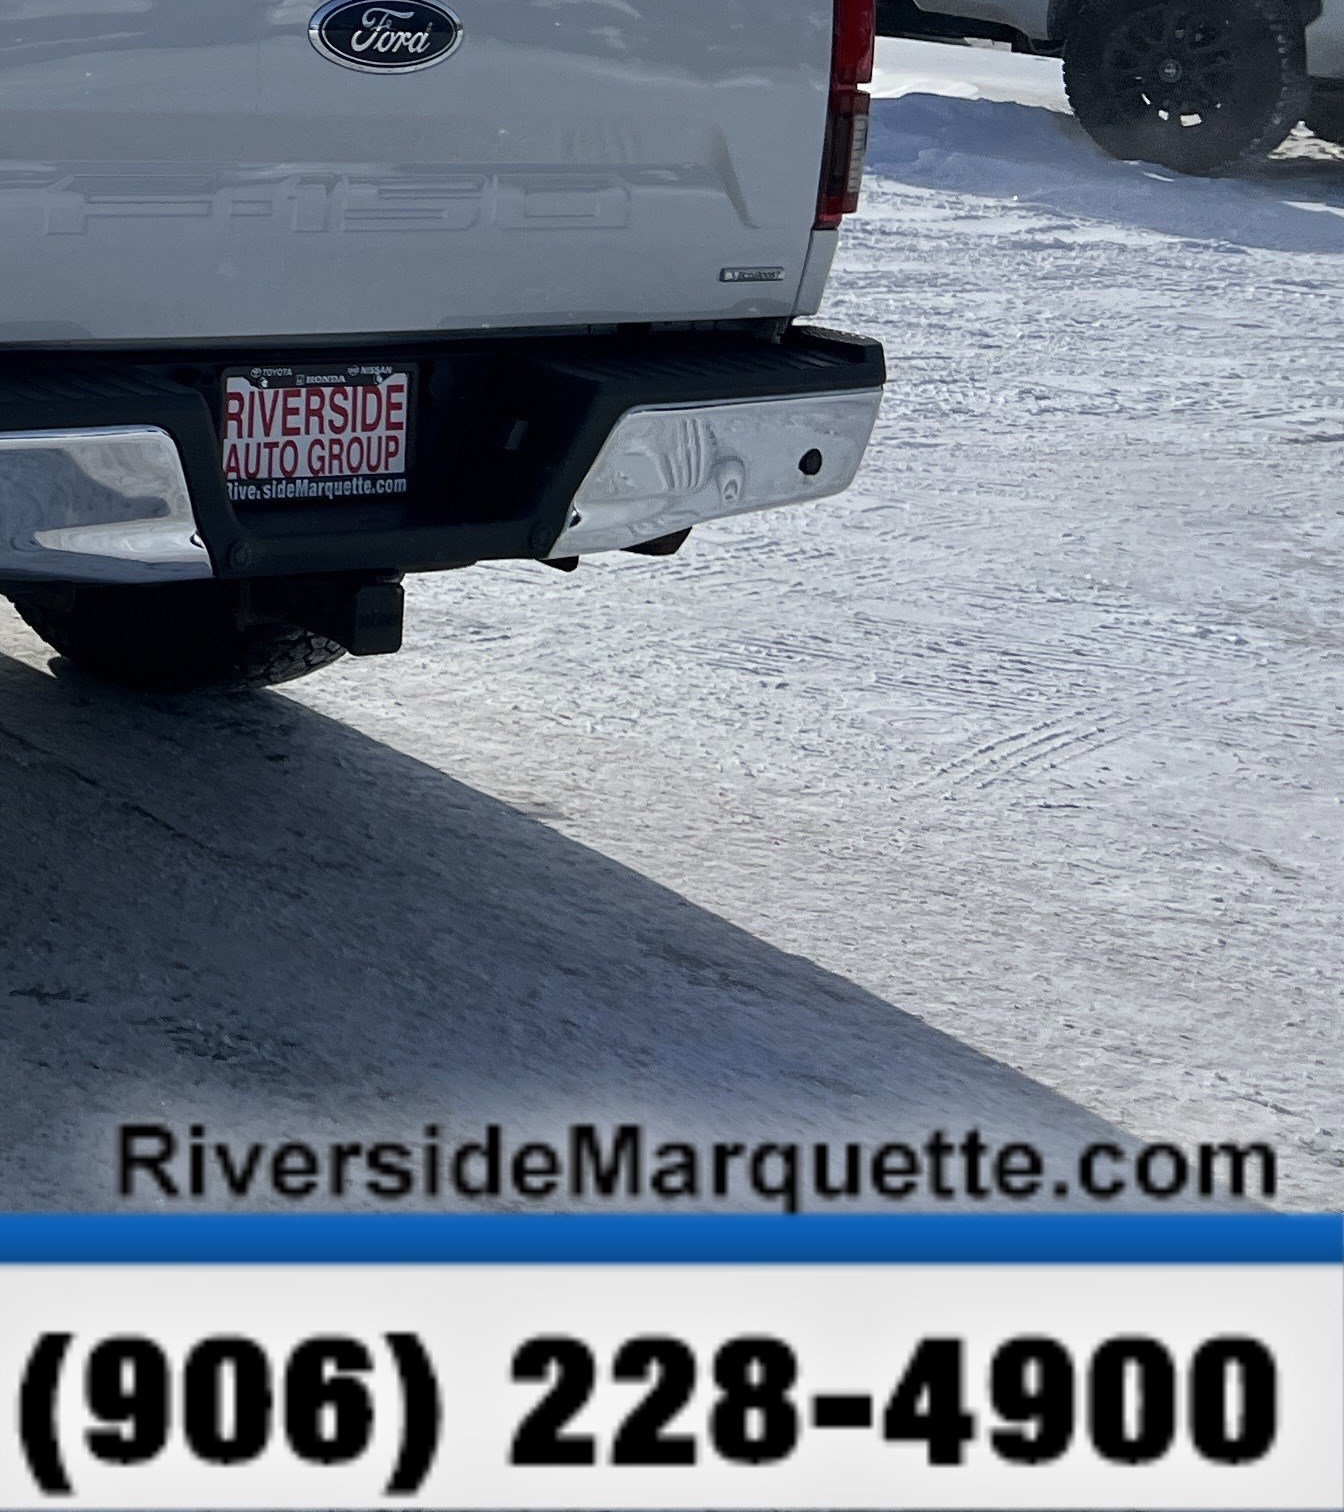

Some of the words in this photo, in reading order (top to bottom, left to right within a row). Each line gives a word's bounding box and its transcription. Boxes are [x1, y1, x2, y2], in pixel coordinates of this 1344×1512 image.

[350, 7, 434, 54] Ford
[262, 367, 293, 377] TOYOTA
[306, 374, 347, 384] HONDA
[360, 366, 393, 376] NISSAN
[224, 384, 405, 439] RIVERSIDE
[225, 440, 299, 480] AUTO
[307, 435, 400, 476] GROUP
